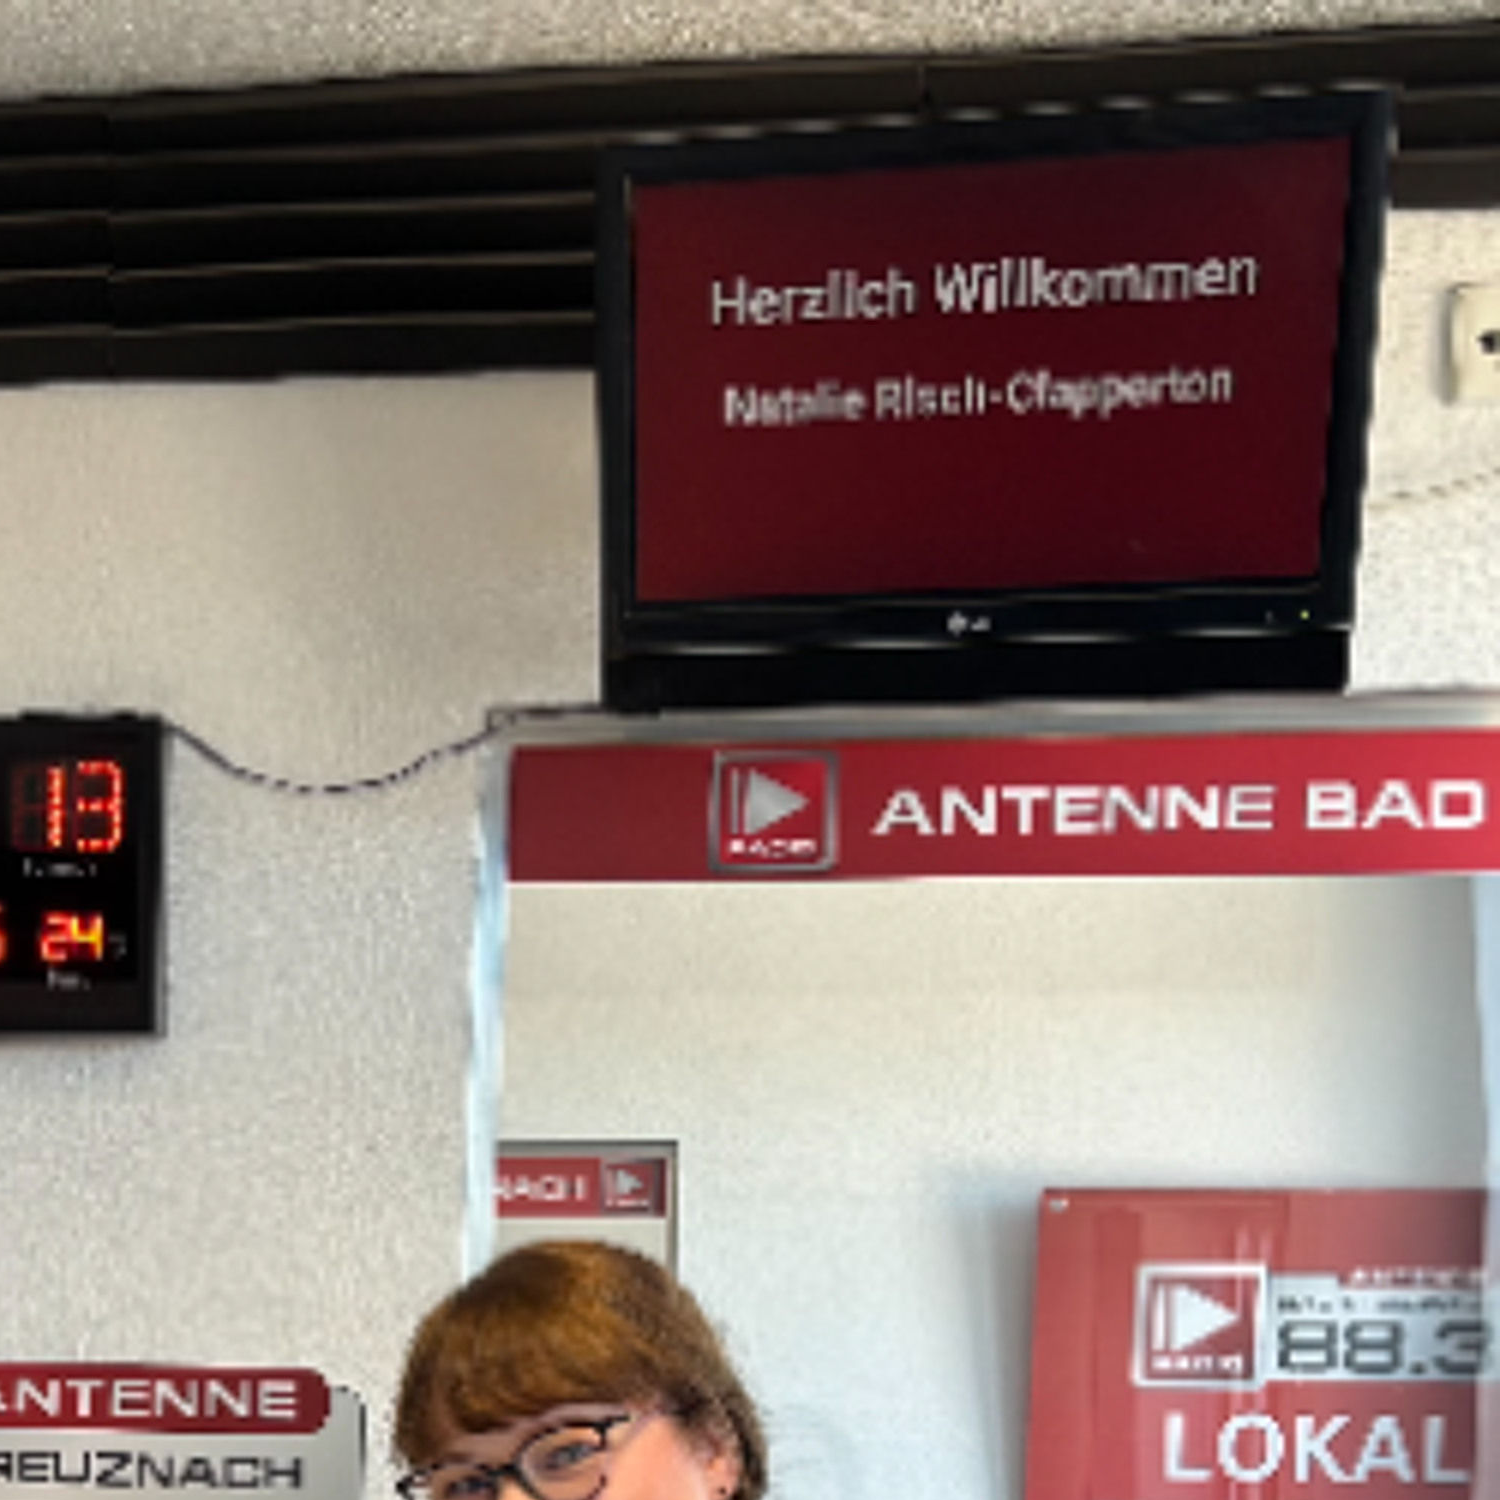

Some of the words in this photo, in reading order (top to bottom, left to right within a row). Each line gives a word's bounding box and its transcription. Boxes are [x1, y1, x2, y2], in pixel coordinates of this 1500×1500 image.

[711, 266, 917, 326] Herzlich
[934, 256, 1257, 314] Willkommen
[45, 760, 122, 853] 13
[872, 783, 1277, 834] ANTENNE
[1304, 779, 1486, 831] BAD
[40, 910, 104, 963] 24
[1277, 1319, 1490, 1376] 88.3
[1163, 1412, 1470, 1484] LOKAL
